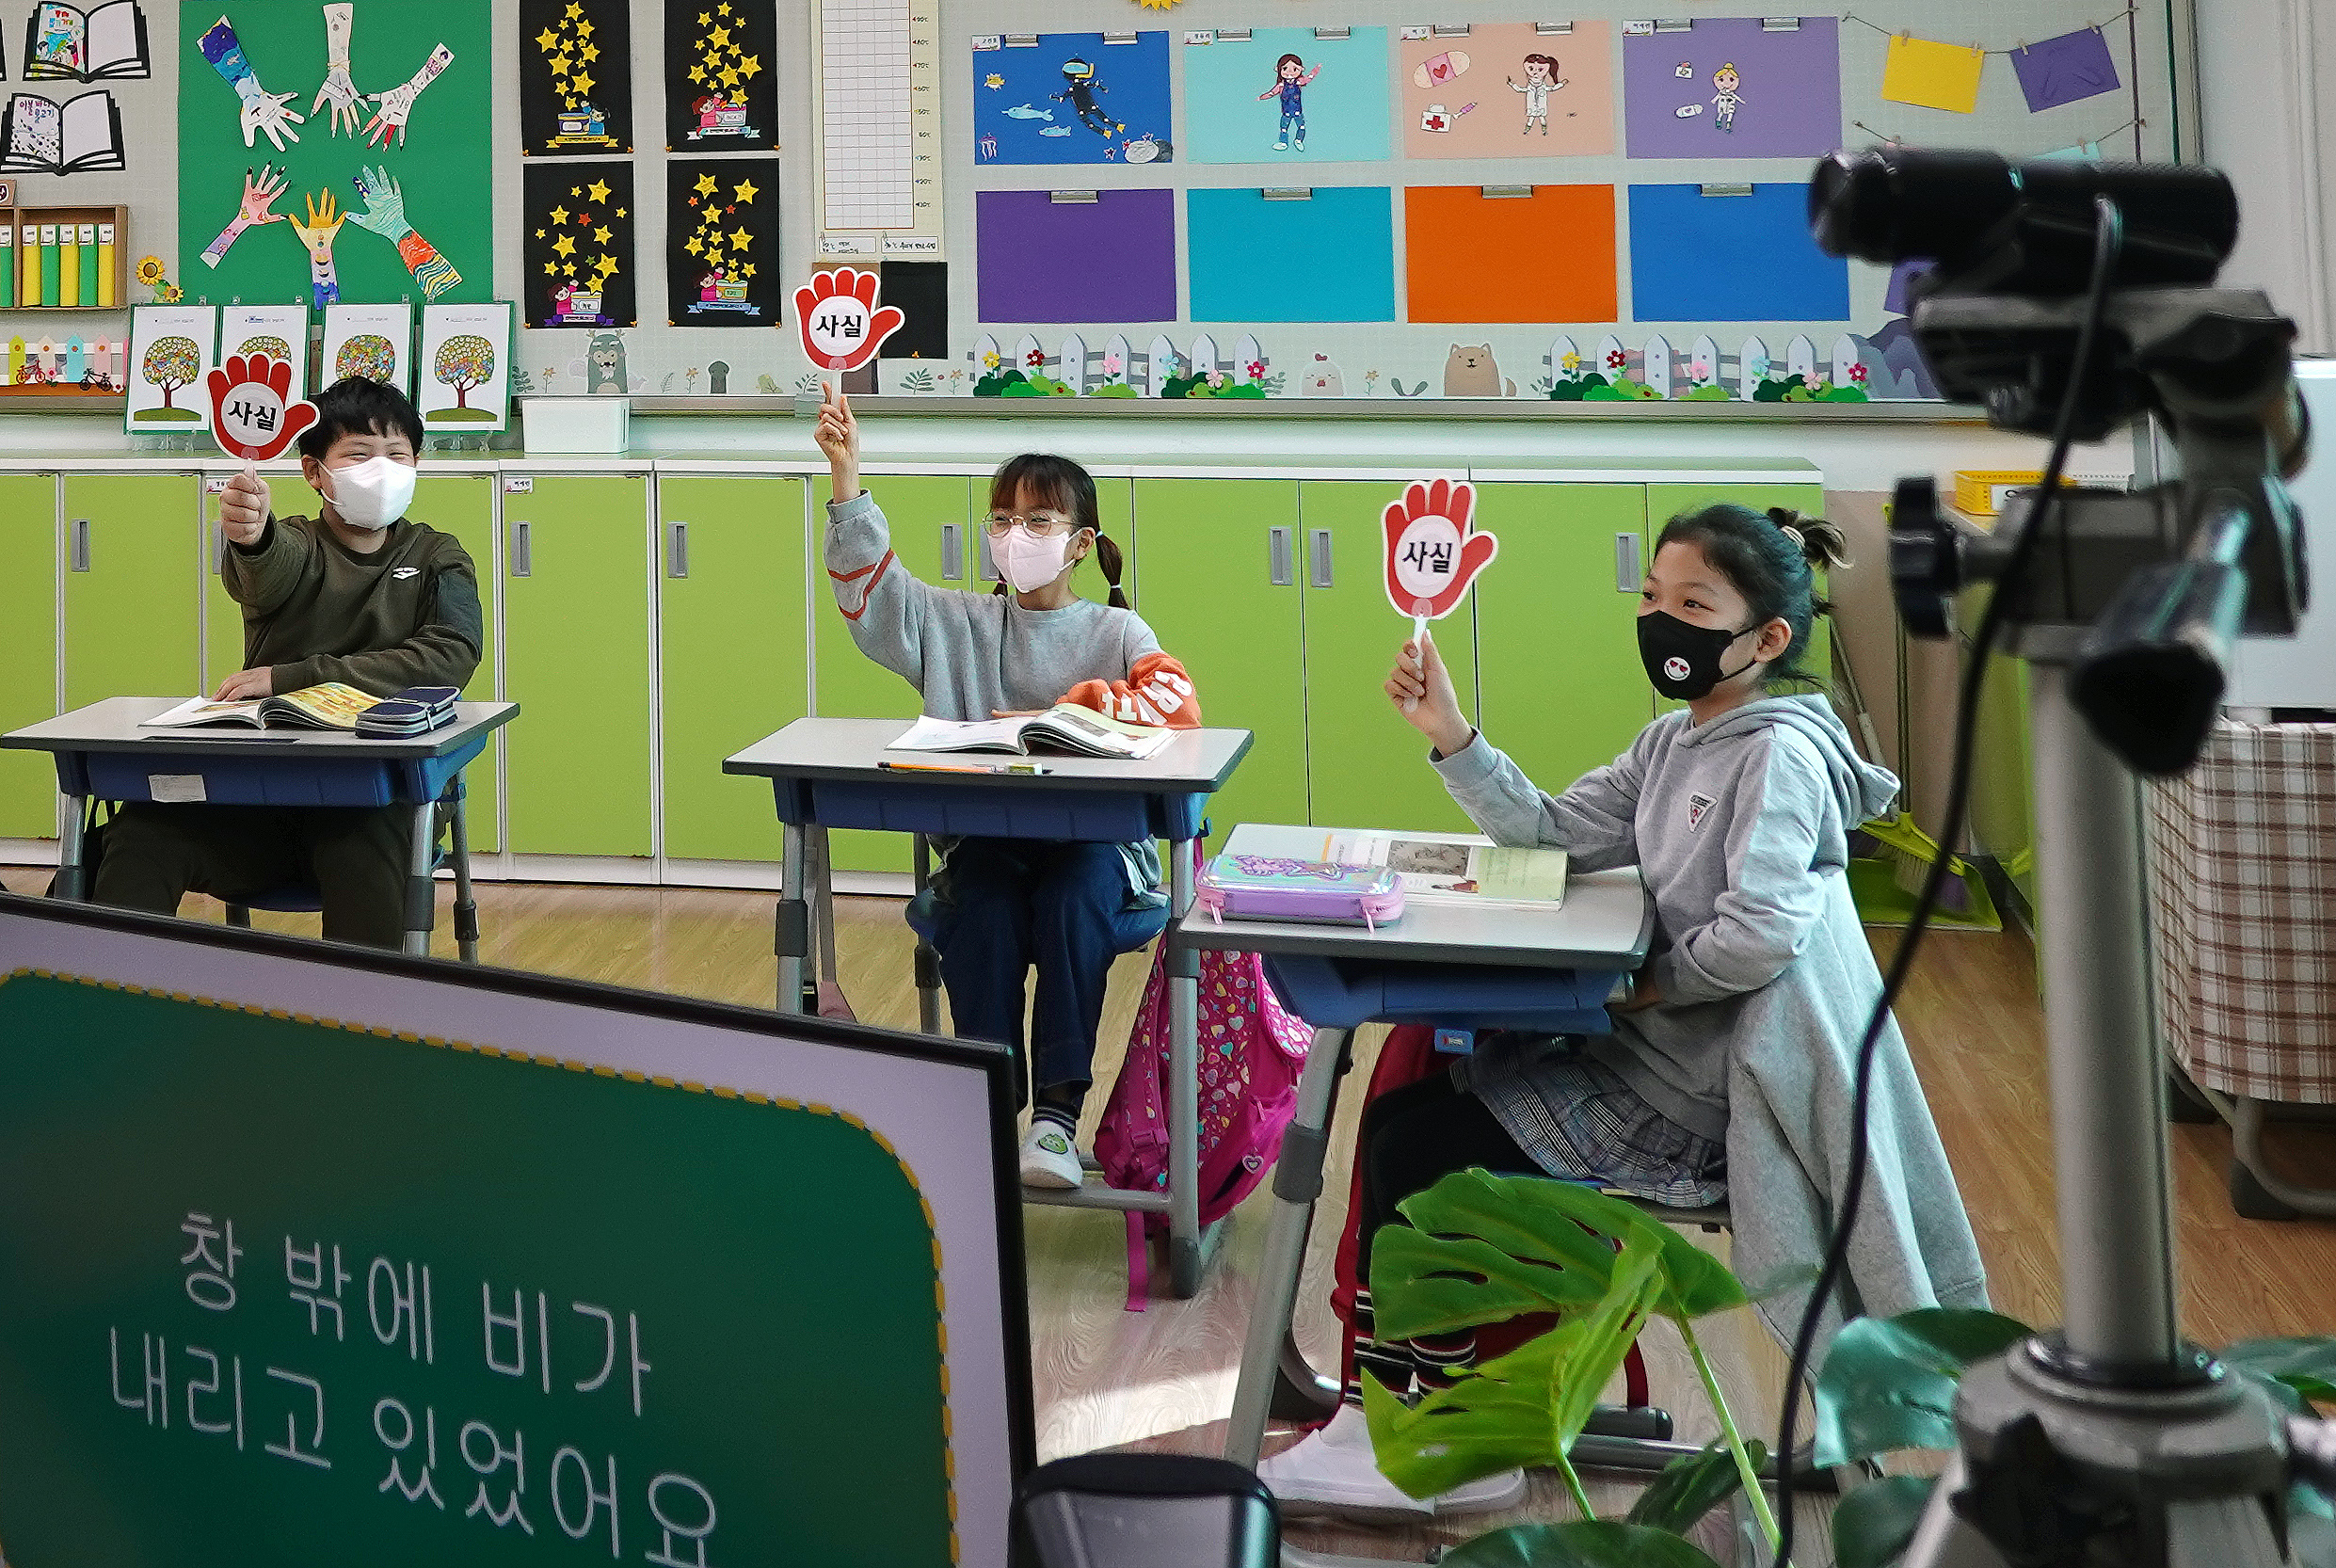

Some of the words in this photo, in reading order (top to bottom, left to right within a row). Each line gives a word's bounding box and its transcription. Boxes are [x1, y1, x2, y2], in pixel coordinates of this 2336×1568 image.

[815, 314, 862, 339] 사실
[227, 400, 277, 432] 사실
[1401, 540, 1452, 573] 사실
[180, 1211, 244, 1312] 창
[283, 1234, 435, 1365] 밖에
[481, 1280, 653, 1417] 비가
[108, 1325, 332, 1469] 내리고
[373, 1396, 717, 1568] 있었어요
